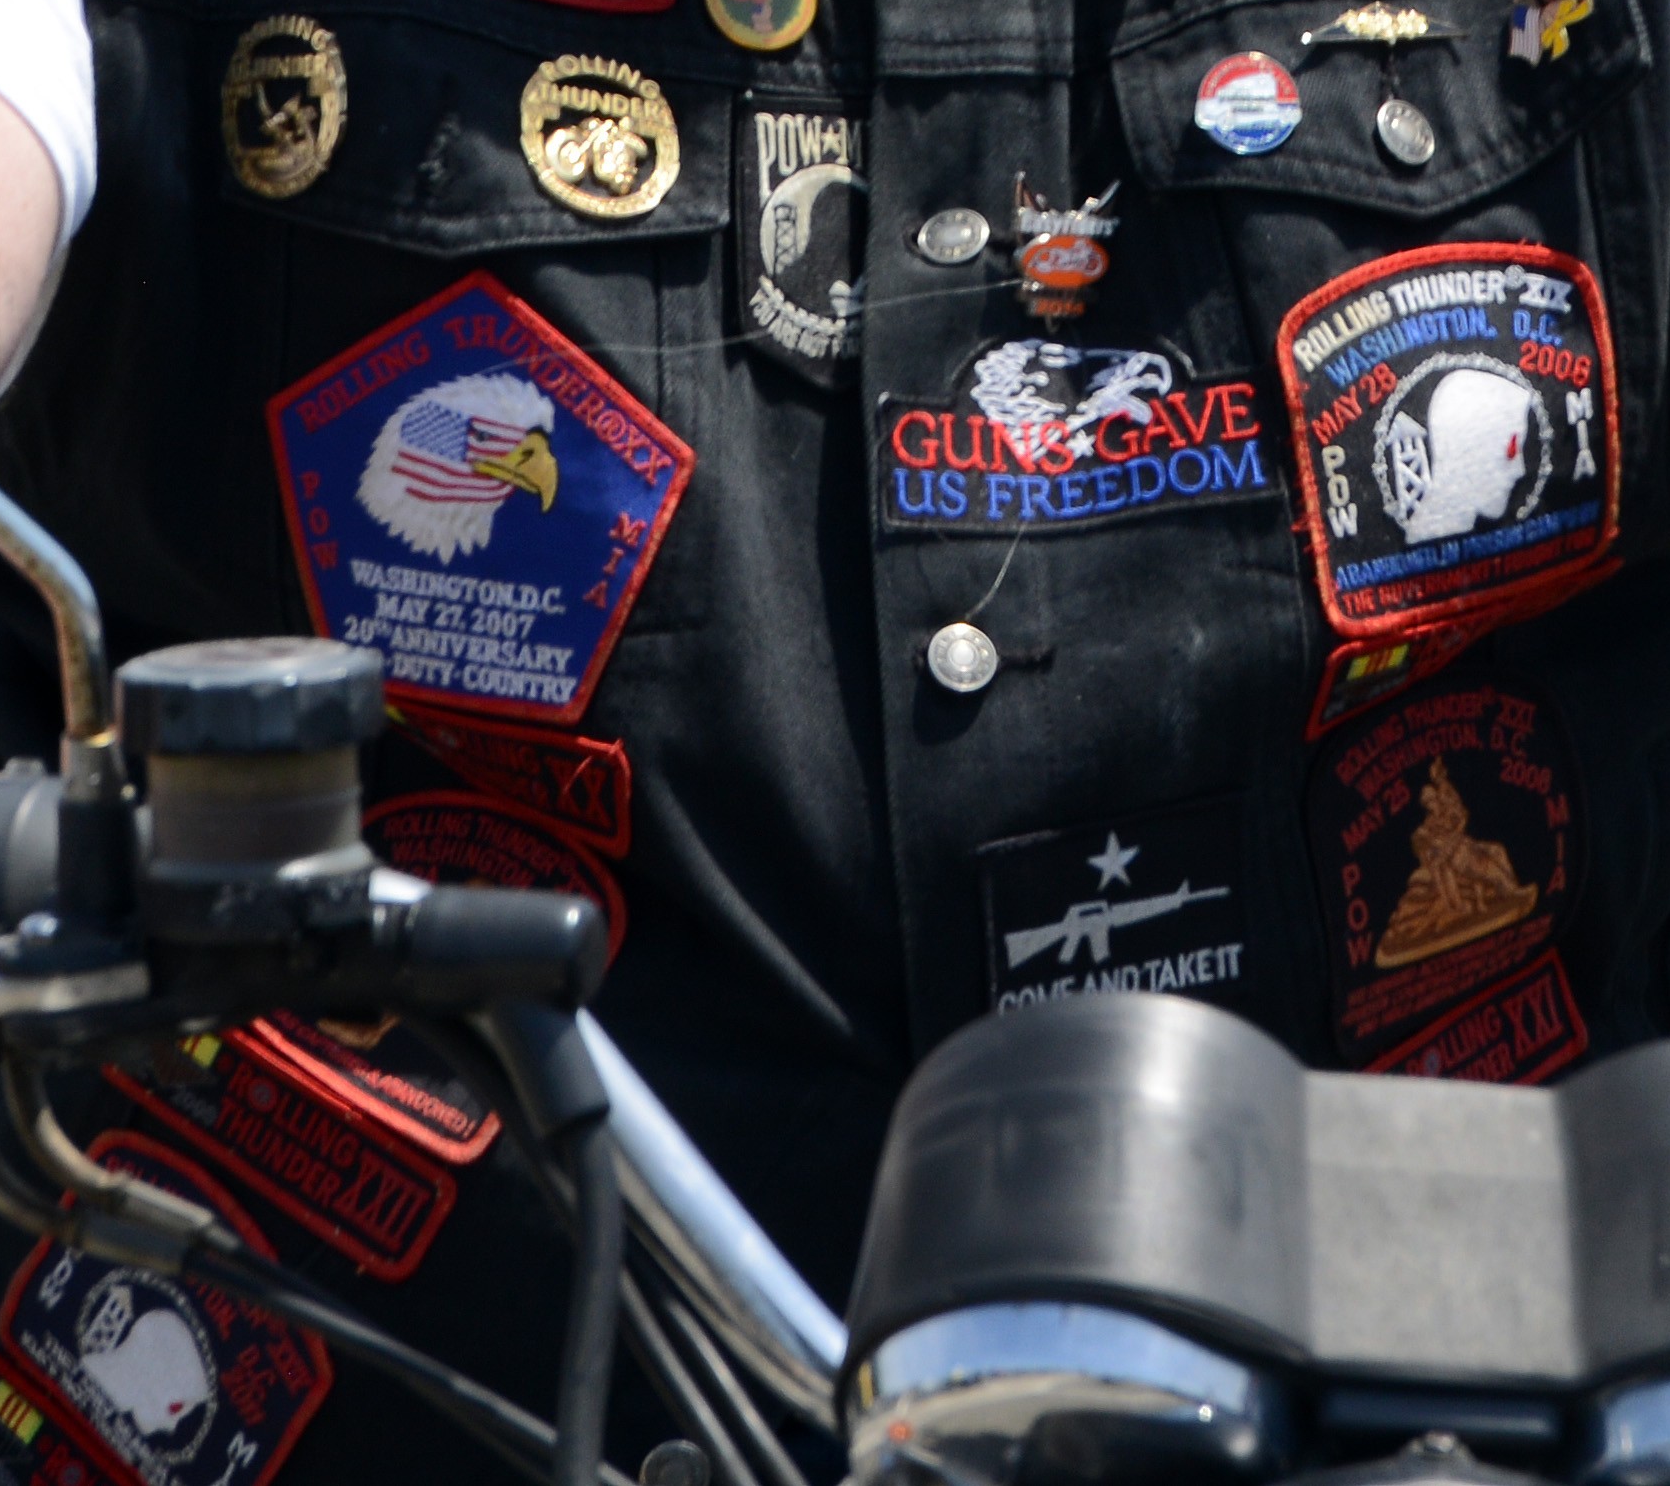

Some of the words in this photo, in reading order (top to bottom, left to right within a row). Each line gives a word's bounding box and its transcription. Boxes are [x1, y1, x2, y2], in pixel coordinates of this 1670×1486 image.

[537, 52, 661, 101] ROLLING
[1291, 290, 1393, 373] ROLLING
[1511, 308, 1565, 347] D.C.
[295, 330, 430, 435] ROLLING
[1310, 388, 1364, 447] MAY
[1357, 360, 1400, 406] 28
[1517, 340, 1594, 388] 2006
[891, 409, 1077, 476] GUNS
[1091, 382, 1262, 463] GAVE
[1564, 385, 1598, 484] MIA
[299, 470, 340, 572] POW
[892, 467, 970, 519] US
[985, 437, 1268, 522] FREEDOM
[1319, 442, 1361, 540] POW
[582, 511, 647, 611] MIA
[1340, 588, 1377, 618] THE
[375, 592, 431, 628] MAY
[434, 601, 467, 629] 27,
[471, 607, 538, 638] 2007
[388, 622, 575, 676] ANNIVERSARY
[1335, 714, 1405, 786] ROLLING
[1489, 726, 1529, 759] D.C.
[1340, 802, 1386, 854] MAY
[1545, 791, 1571, 897] MIA
[1341, 861, 1374, 969] POW
[1082, 964, 1141, 995] AND
[1140, 947, 1214, 993] TAKE
[1215, 942, 1244, 980] IT
[1500, 973, 1569, 1055] XXI
[212, 1097, 342, 1209] THUNDER
[228, 1063, 364, 1168] ROLLING
[331, 1147, 434, 1255] XXII
[38, 1254, 76, 1311] OW
